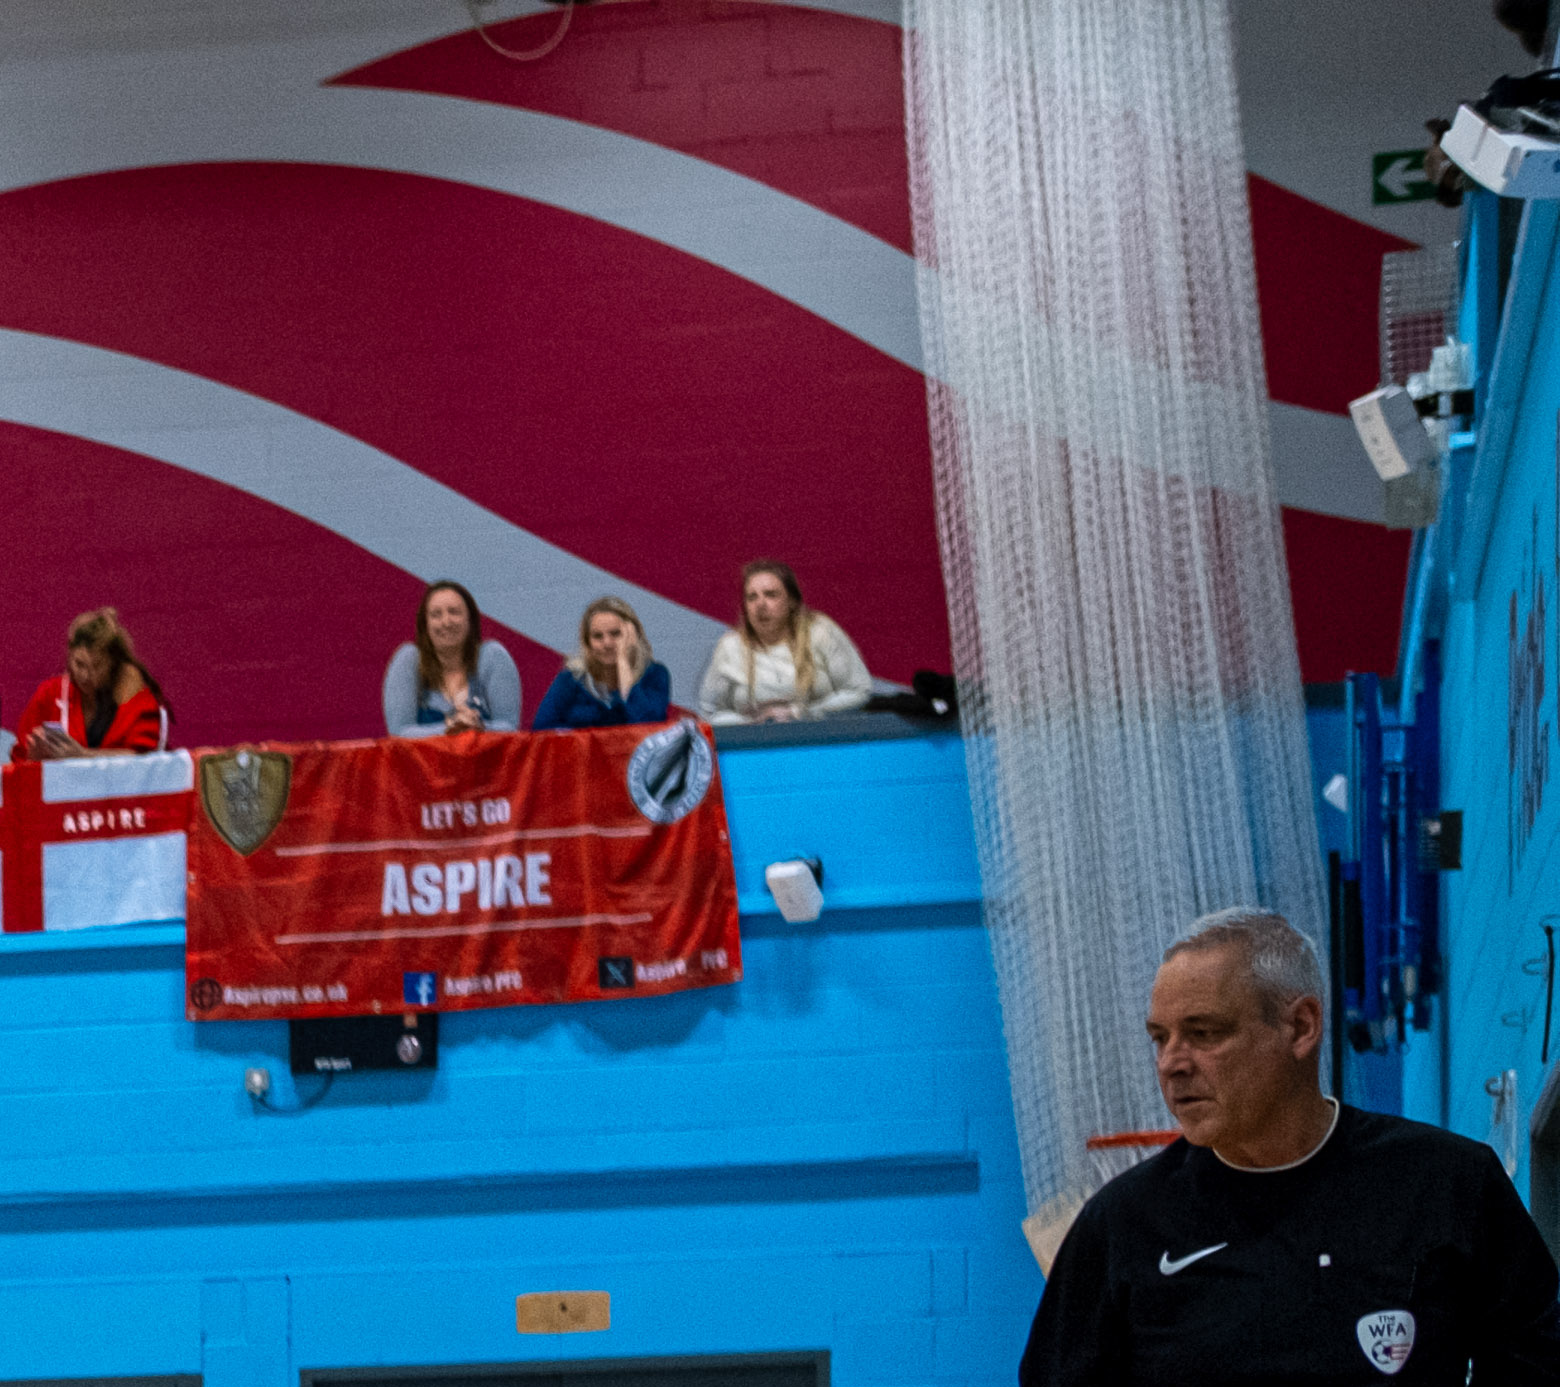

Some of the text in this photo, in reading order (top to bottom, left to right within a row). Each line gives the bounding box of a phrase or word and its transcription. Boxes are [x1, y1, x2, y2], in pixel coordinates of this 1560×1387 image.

[63, 806, 147, 834] ASPIRE
[421, 797, 511, 829] LET'S GO
[381, 851, 552, 917] ASPIRE
[1368, 1323, 1407, 1339] WFA
